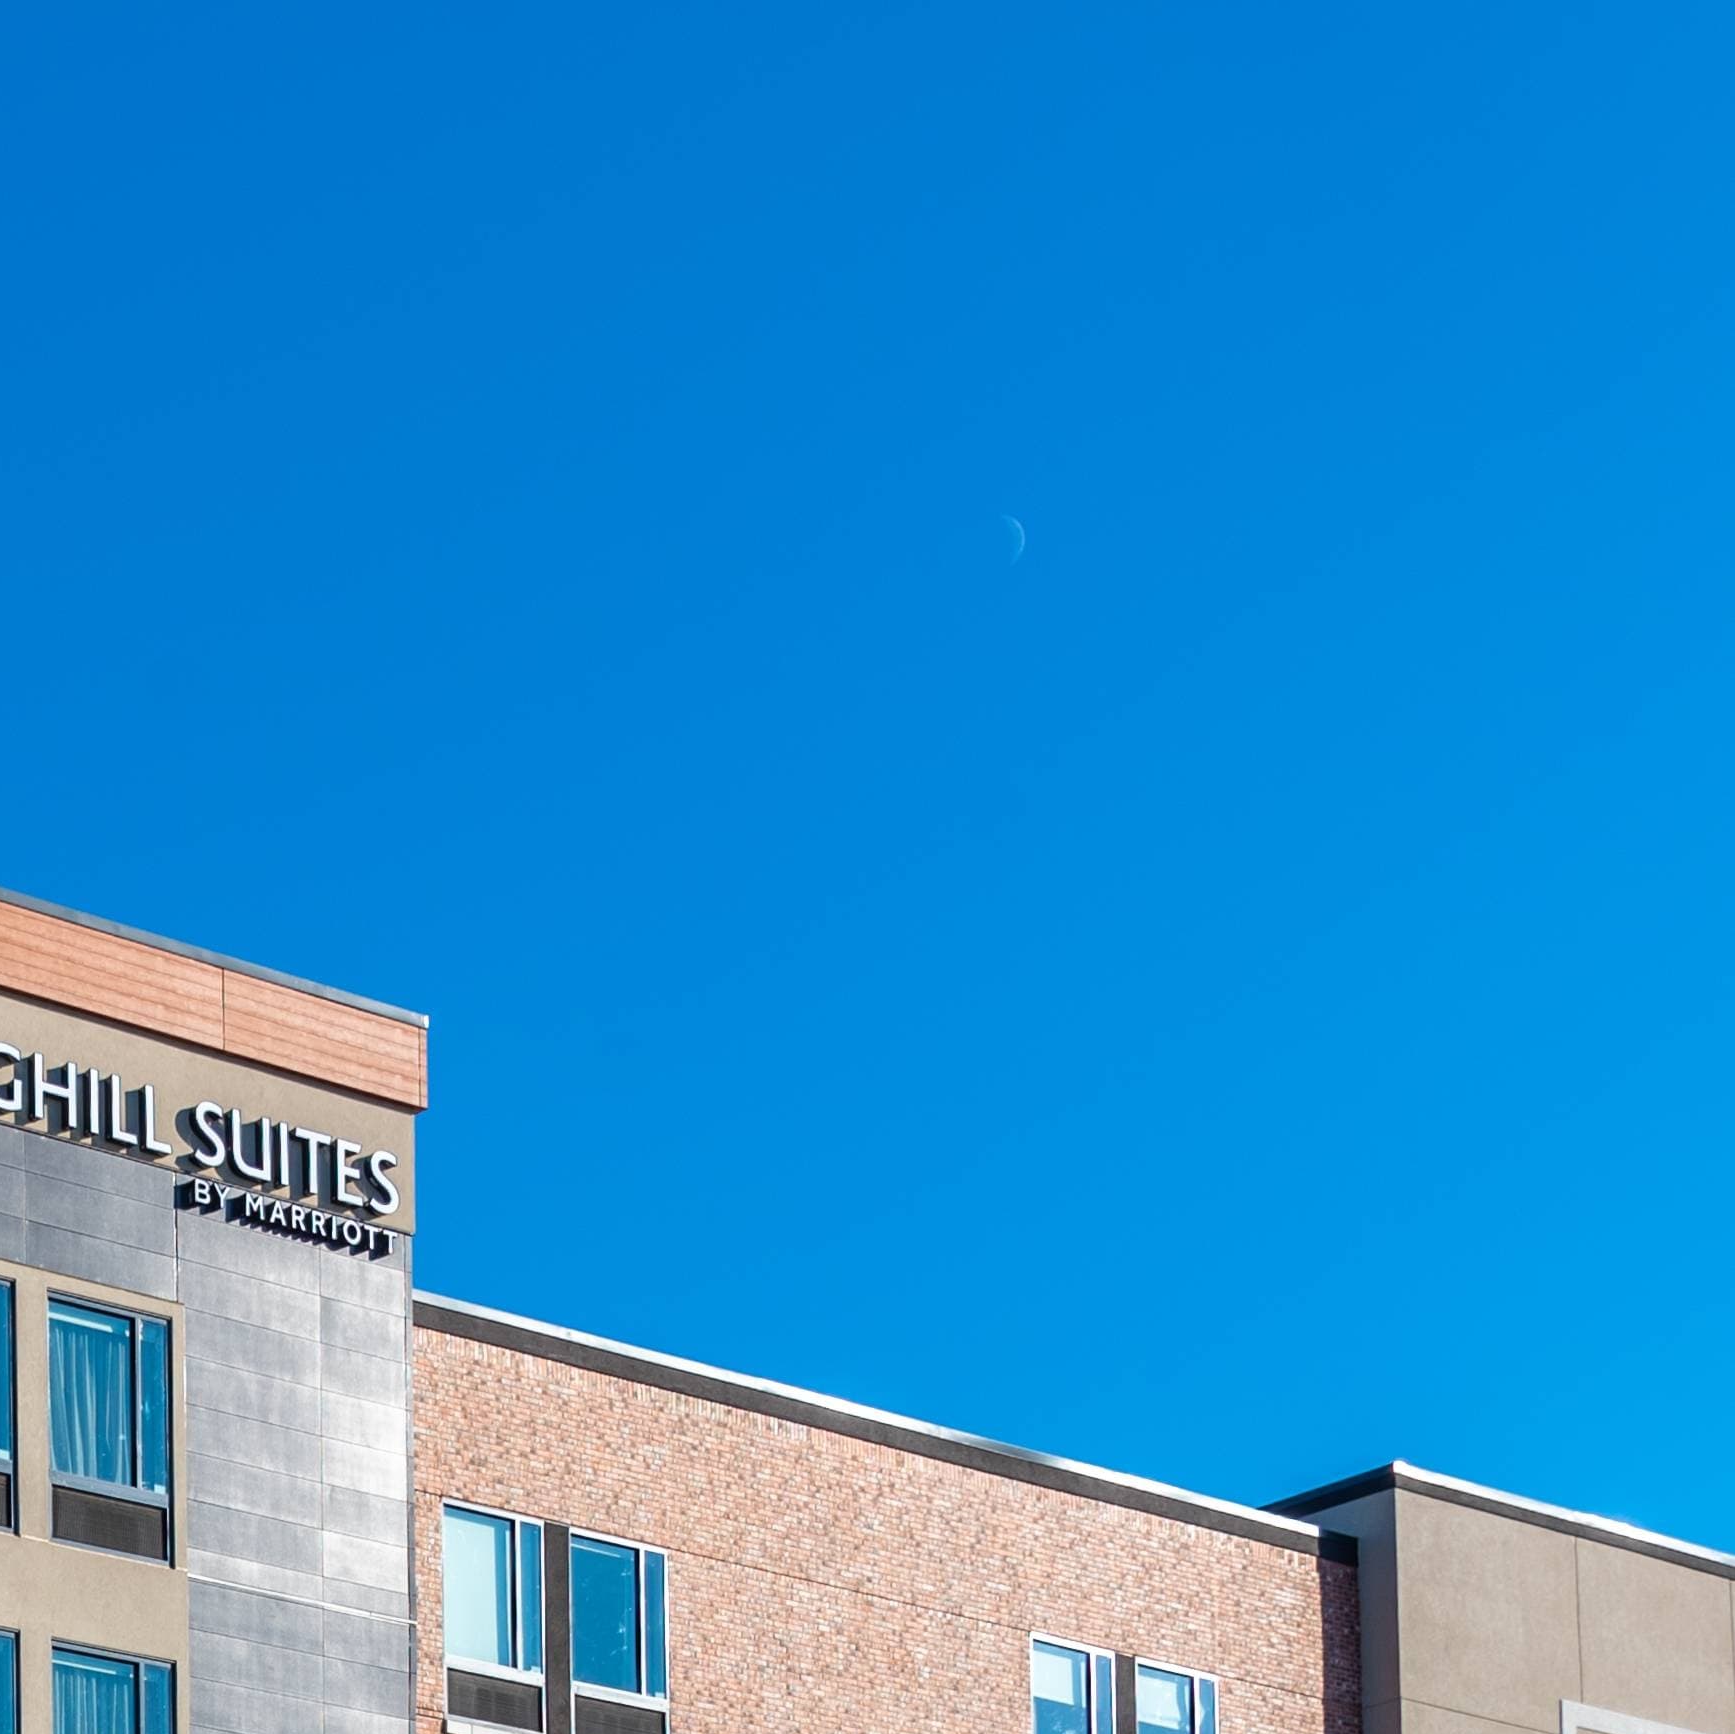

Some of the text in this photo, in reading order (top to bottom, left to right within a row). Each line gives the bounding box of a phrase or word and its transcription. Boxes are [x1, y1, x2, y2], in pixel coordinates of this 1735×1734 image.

[193, 1101, 401, 1215] SUITES
[194, 1178, 399, 1255] BY MARRIOTT
